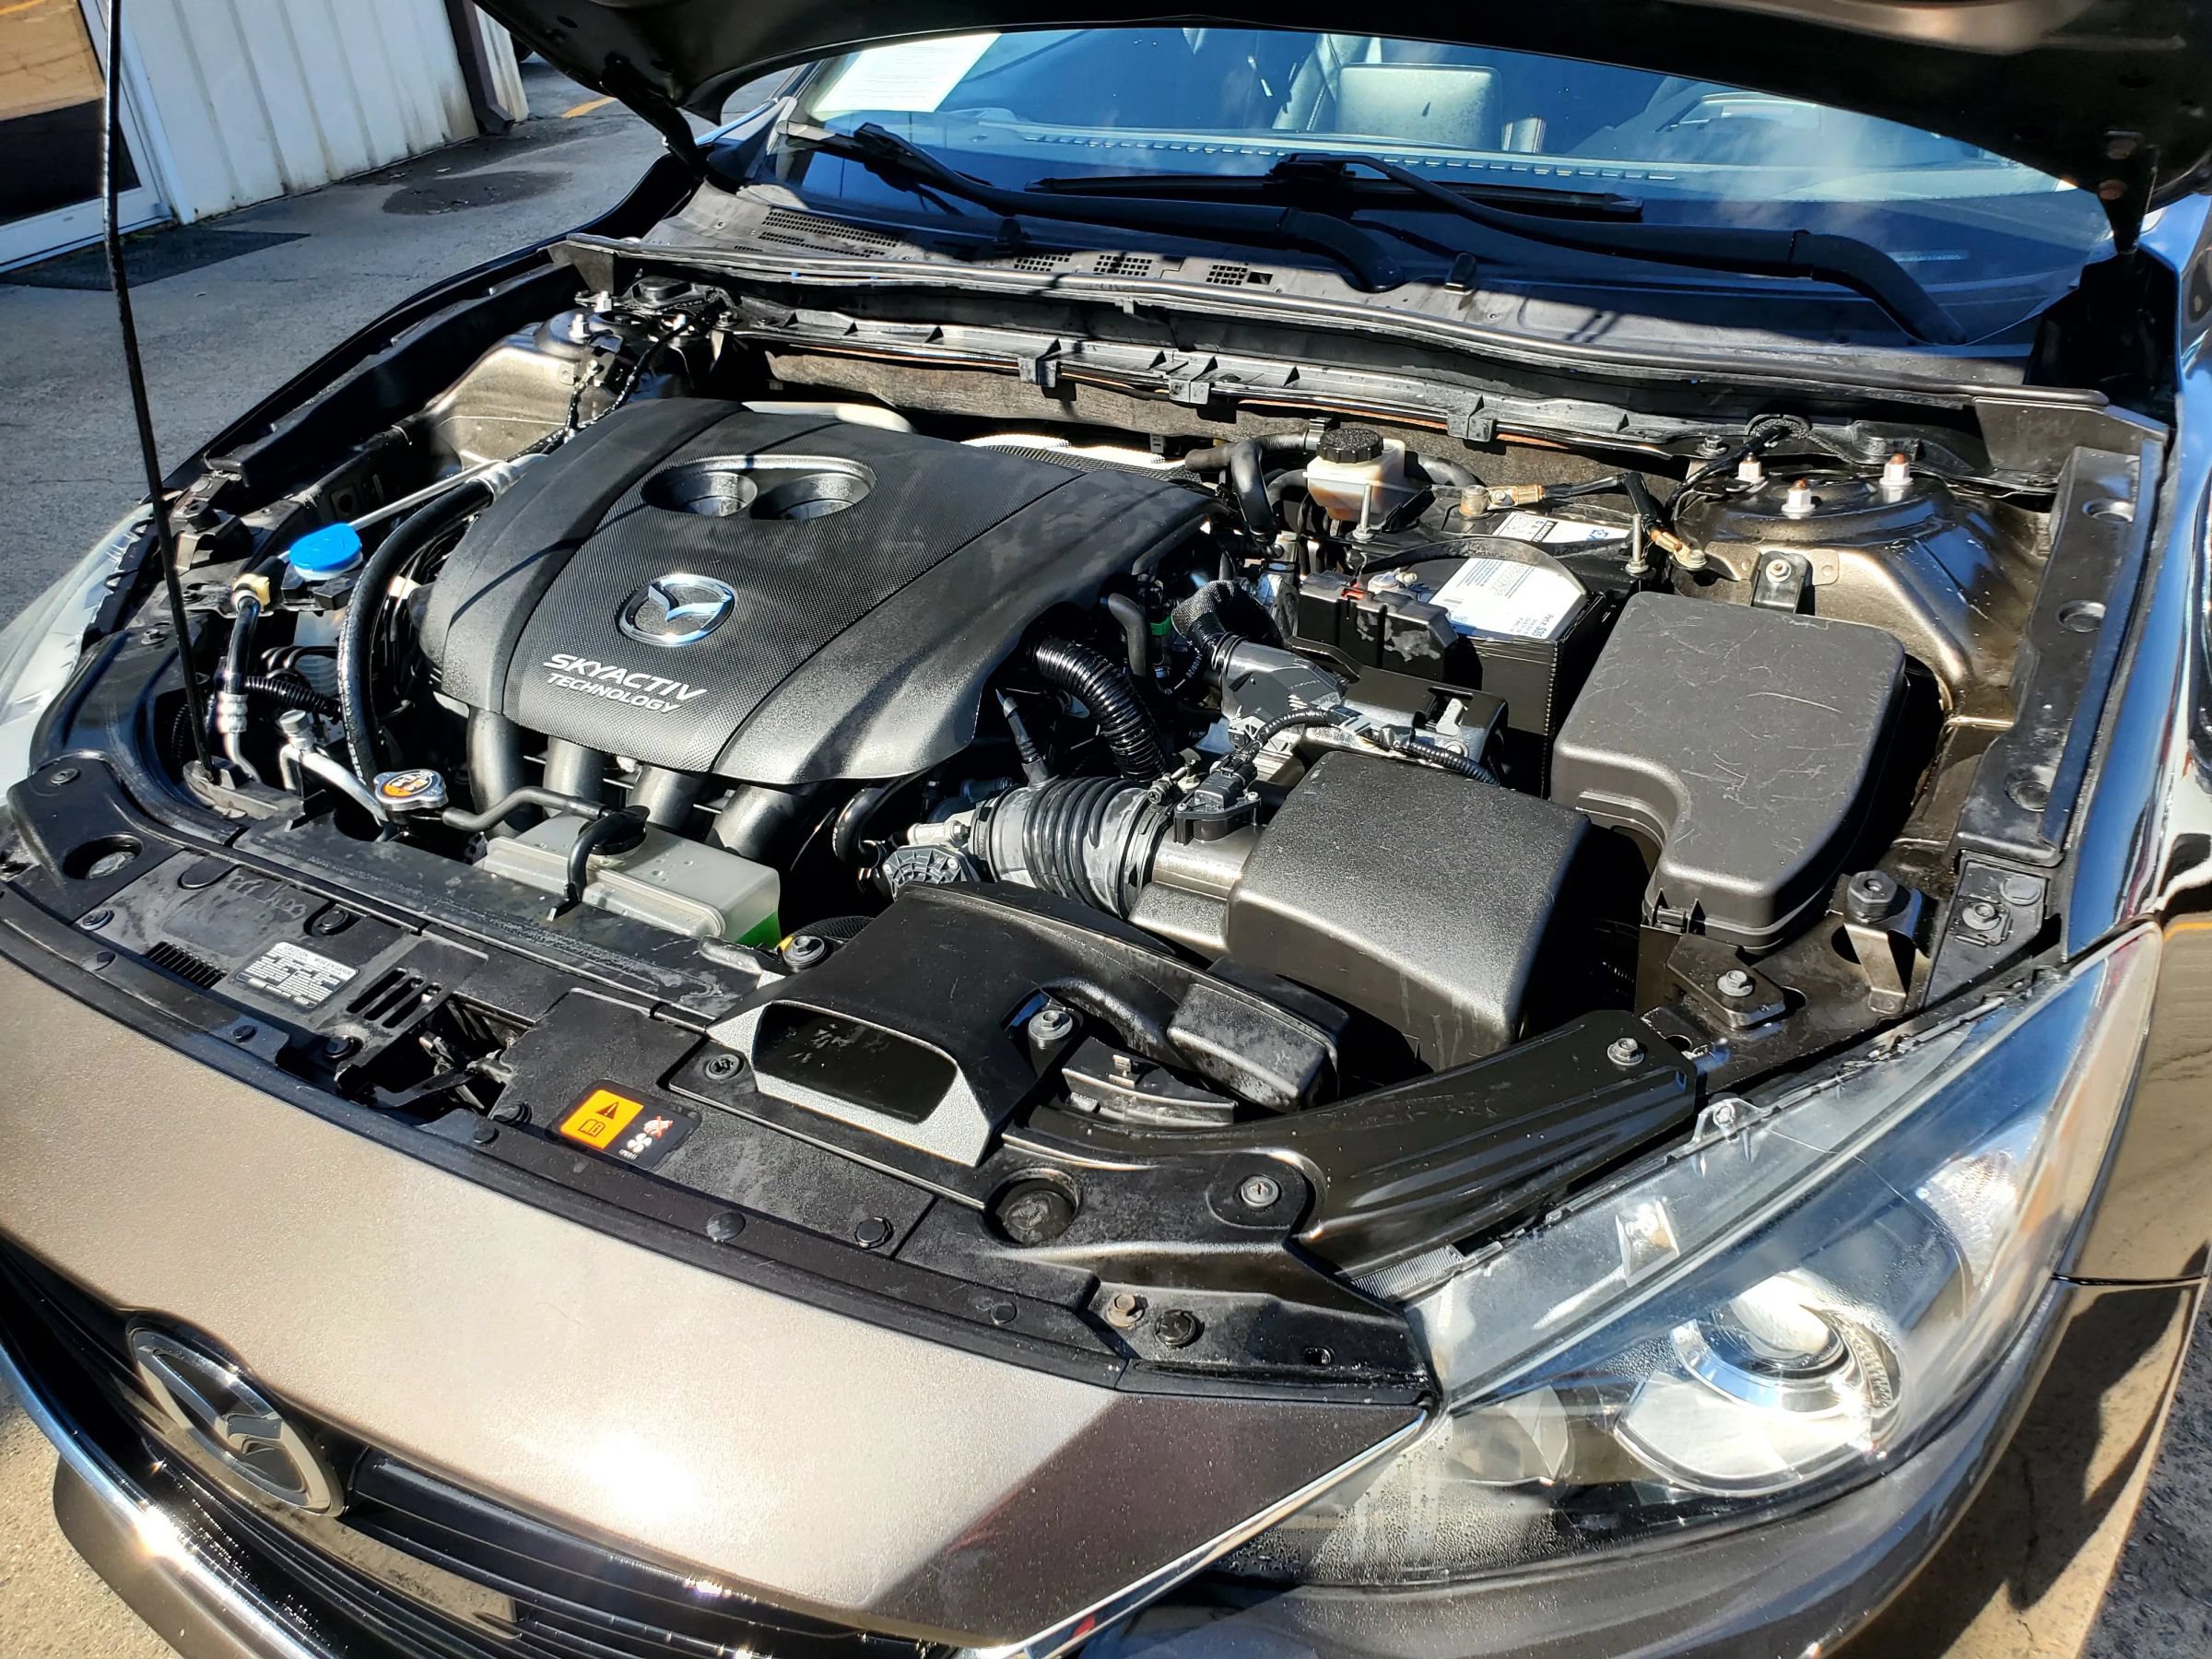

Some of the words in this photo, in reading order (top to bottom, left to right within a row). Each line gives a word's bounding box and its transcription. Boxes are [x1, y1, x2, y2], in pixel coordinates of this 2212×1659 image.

[543, 653, 708, 700] SKYACTIV
[547, 673, 683, 713] TECHNOLOGY
[284, 945, 309, 958] CAUTION
